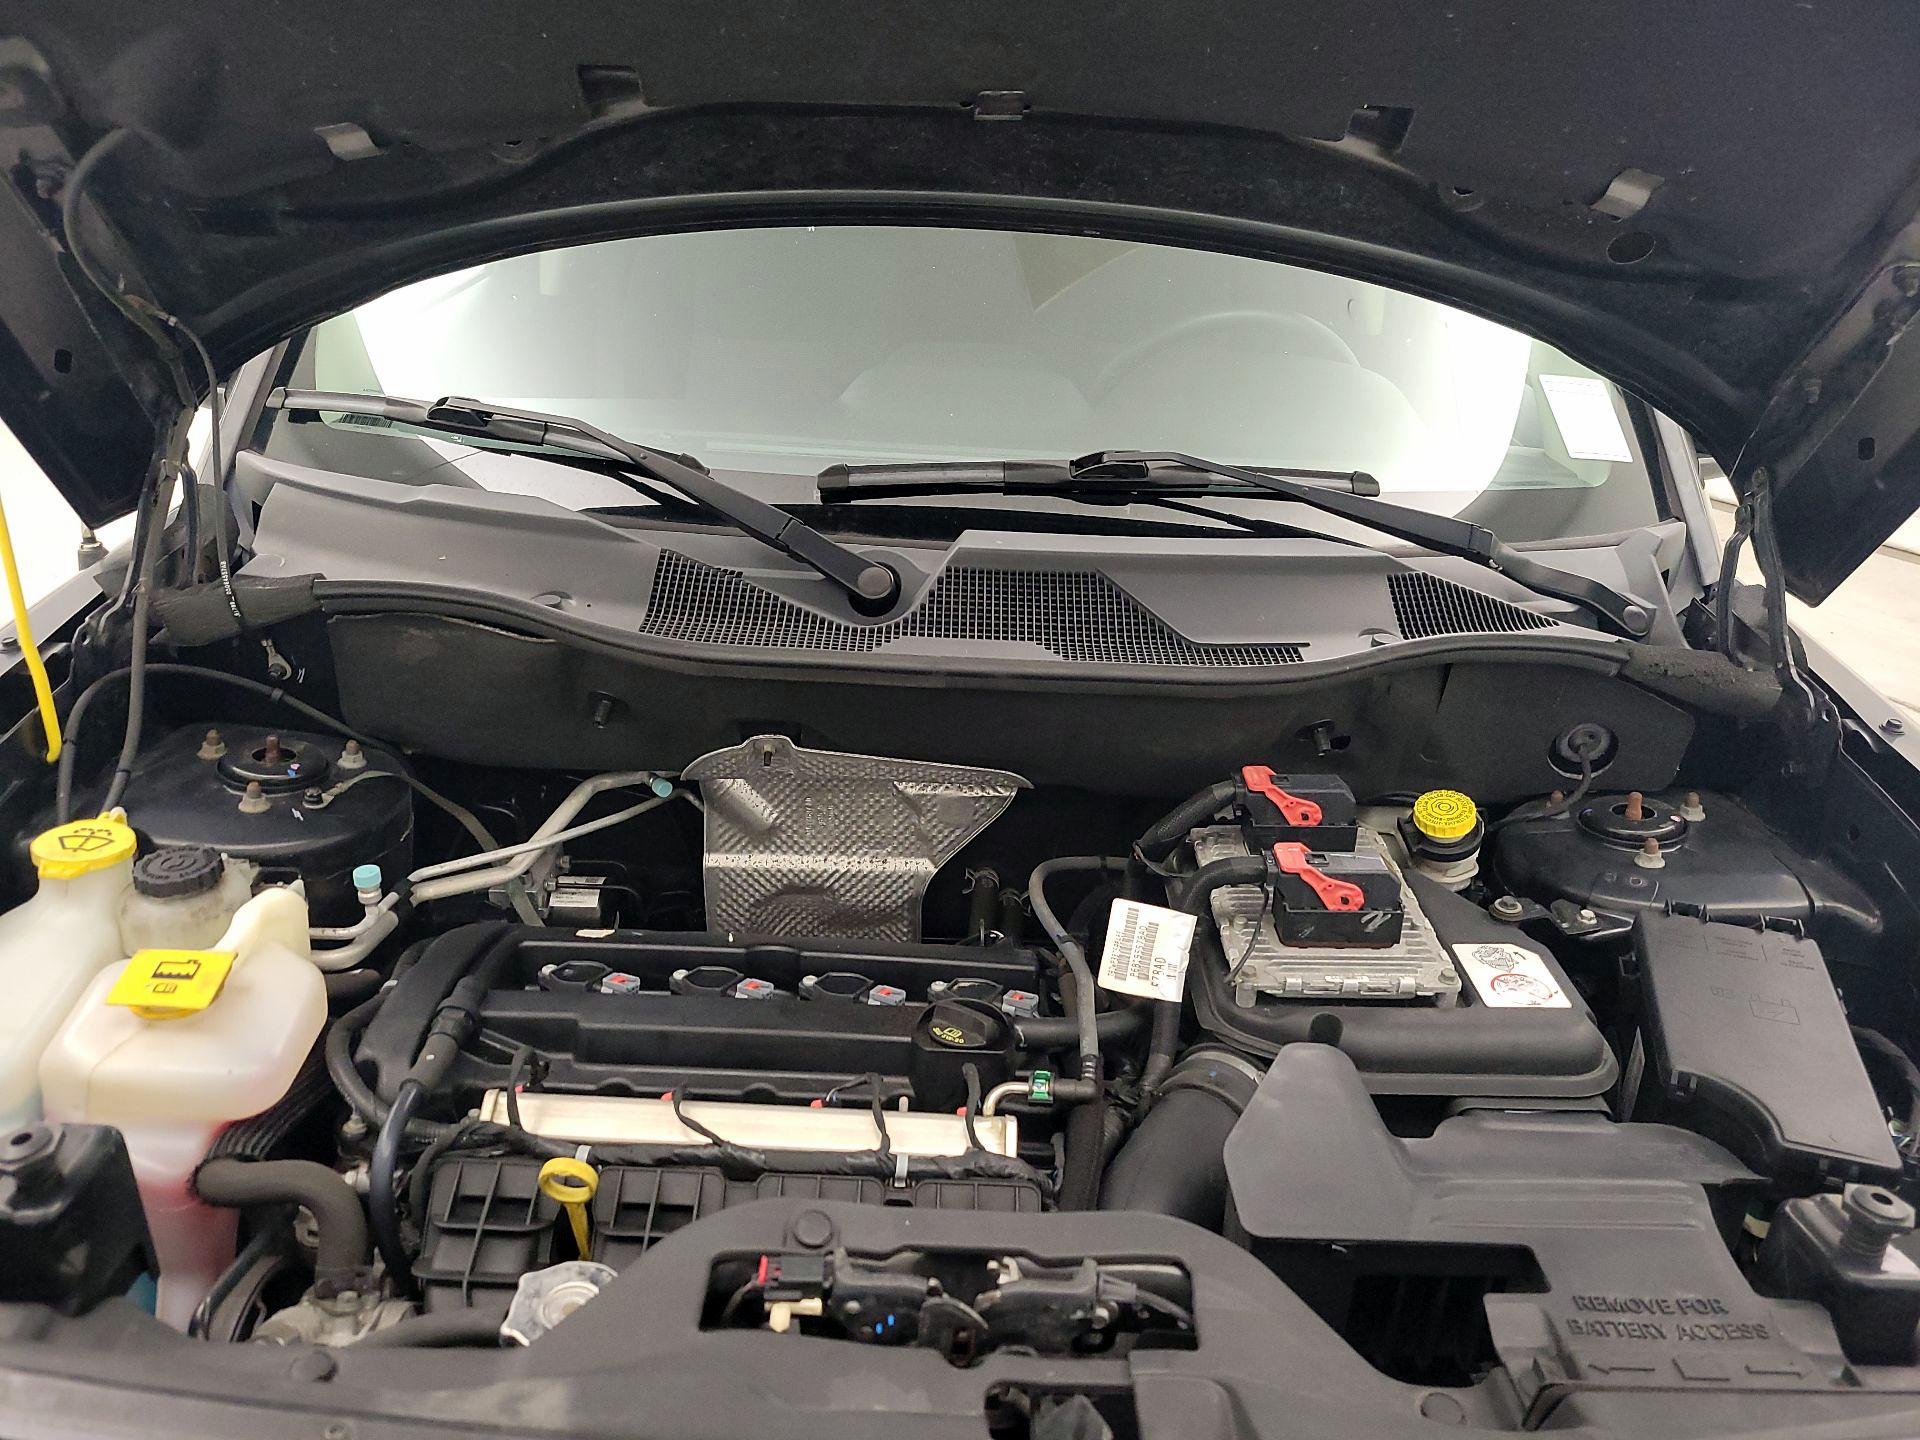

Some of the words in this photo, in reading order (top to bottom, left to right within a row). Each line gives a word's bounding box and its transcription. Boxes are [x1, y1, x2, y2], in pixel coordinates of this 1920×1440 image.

[1572, 1294, 1675, 1315] REMOVE
[1675, 1297, 1729, 1315] FOR
[1566, 1318, 1668, 1340] BATTERY
[1676, 1322, 1771, 1342] ACCESS
